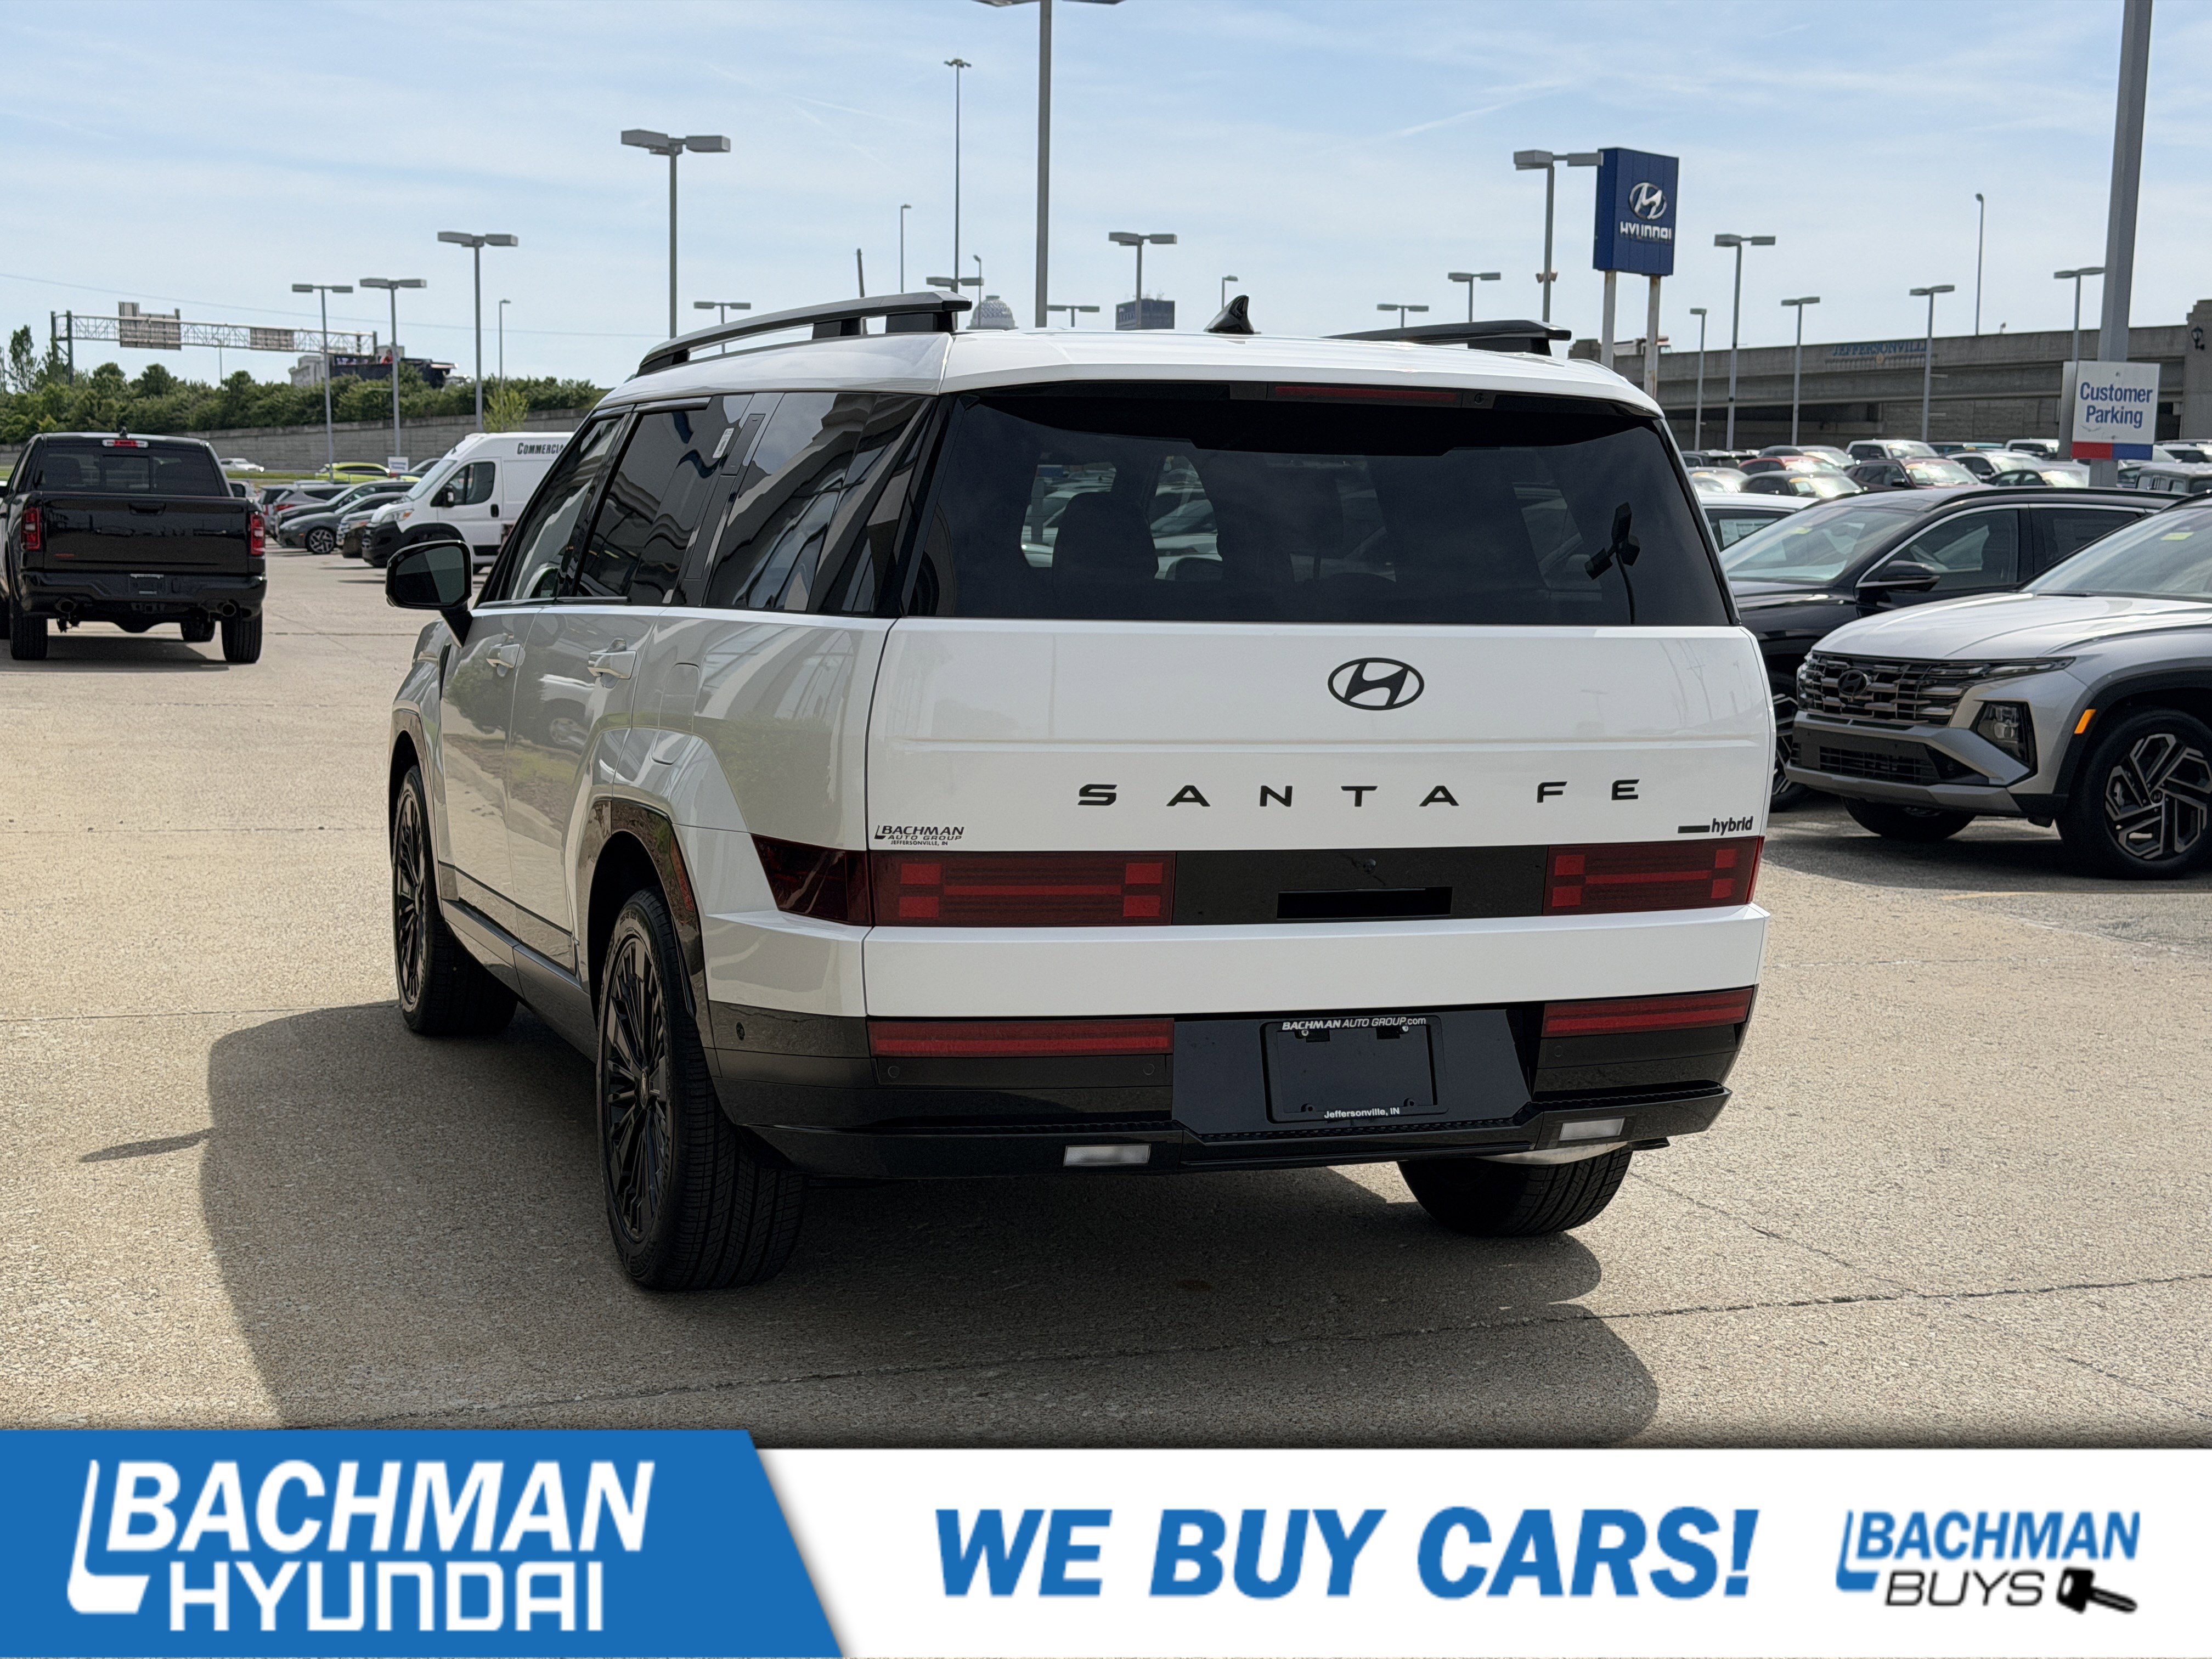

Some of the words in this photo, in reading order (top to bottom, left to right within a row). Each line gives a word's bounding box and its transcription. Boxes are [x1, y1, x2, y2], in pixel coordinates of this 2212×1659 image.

[1620, 221, 1672, 240] HYUNDAI
[2080, 382, 2153, 403] Customer
[2086, 405, 2143, 429] Parking
[1077, 784, 1459, 807] SANTA
[1537, 779, 1640, 803] FE
[881, 825, 964, 836] BACHMAN
[1711, 815, 1754, 836] hybrid
[1282, 1019, 1341, 1030] BACHMAN
[1344, 1018, 1369, 1028] AUTO
[1324, 1108, 1389, 1119] Jeffersonville,
